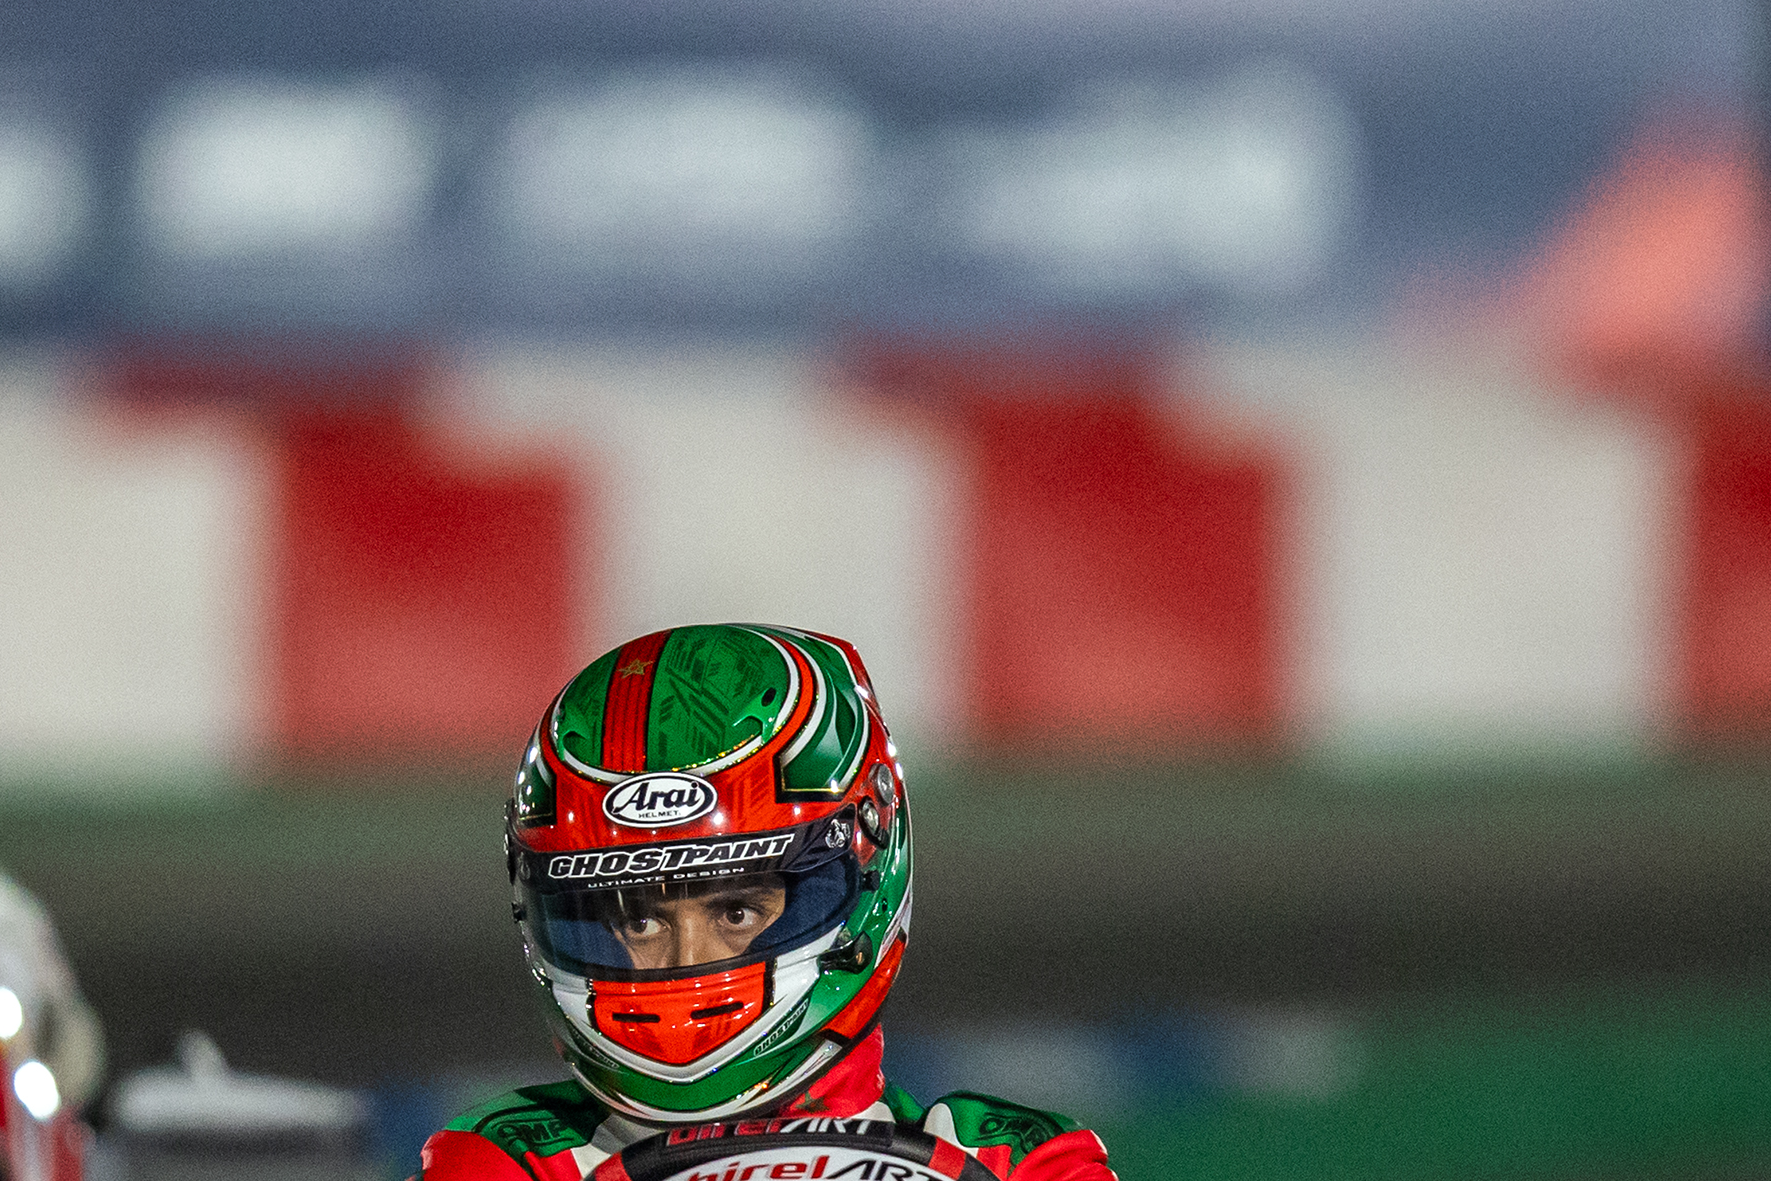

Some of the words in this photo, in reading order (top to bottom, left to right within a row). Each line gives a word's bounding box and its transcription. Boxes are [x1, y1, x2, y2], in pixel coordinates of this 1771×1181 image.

[612, 781, 700, 815] Arai
[548, 833, 794, 879] GHOSTPAINT
[587, 873, 668, 889] ULTIMATE
[673, 866, 745, 880] DESIGN
